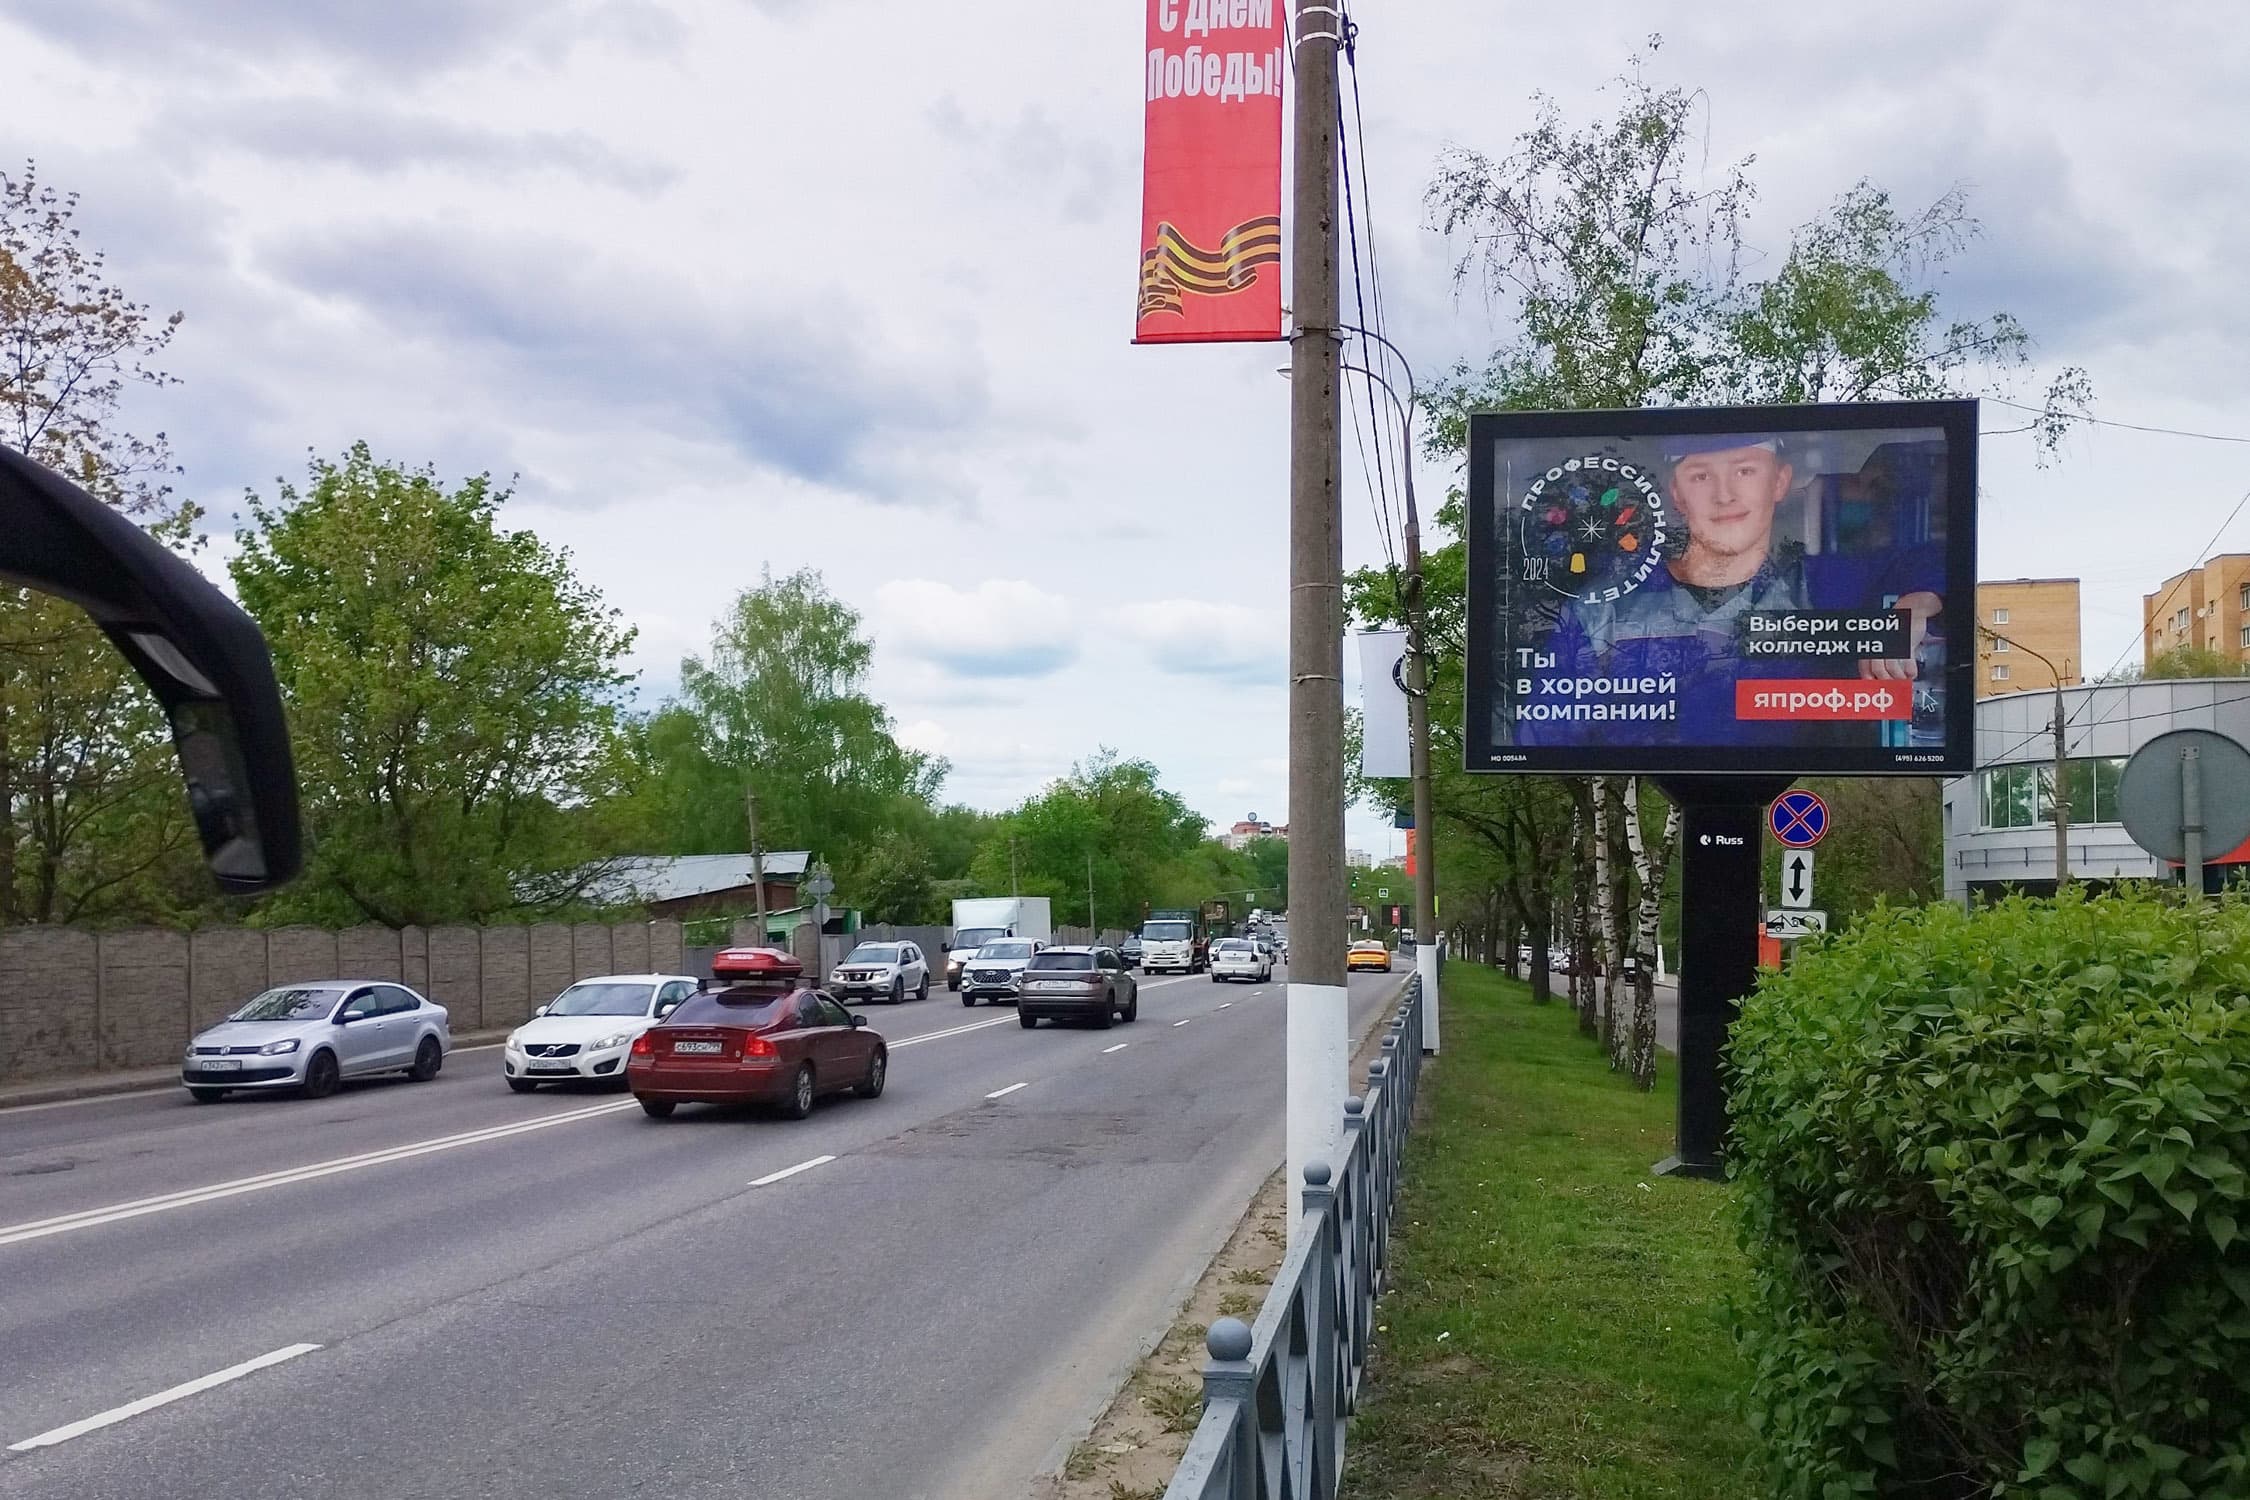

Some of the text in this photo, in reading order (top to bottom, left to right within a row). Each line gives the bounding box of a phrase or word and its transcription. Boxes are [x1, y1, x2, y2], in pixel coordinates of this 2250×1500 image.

[1147, 45, 1282, 104] Победы!
[1521, 457, 1666, 604] ПРОФЕССИОНАЛИТЕТ
[1523, 557, 1549, 581] 2024
[1750, 615, 1899, 635] Выбери свой
[1516, 648, 1556, 668] Ты
[1750, 640, 1884, 655] колледж на
[1516, 672, 1677, 699] в хорошей
[1516, 700, 1676, 720] компании!
[1754, 688, 1894, 712] япроф.рф
[1716, 835, 1744, 845] Russ
